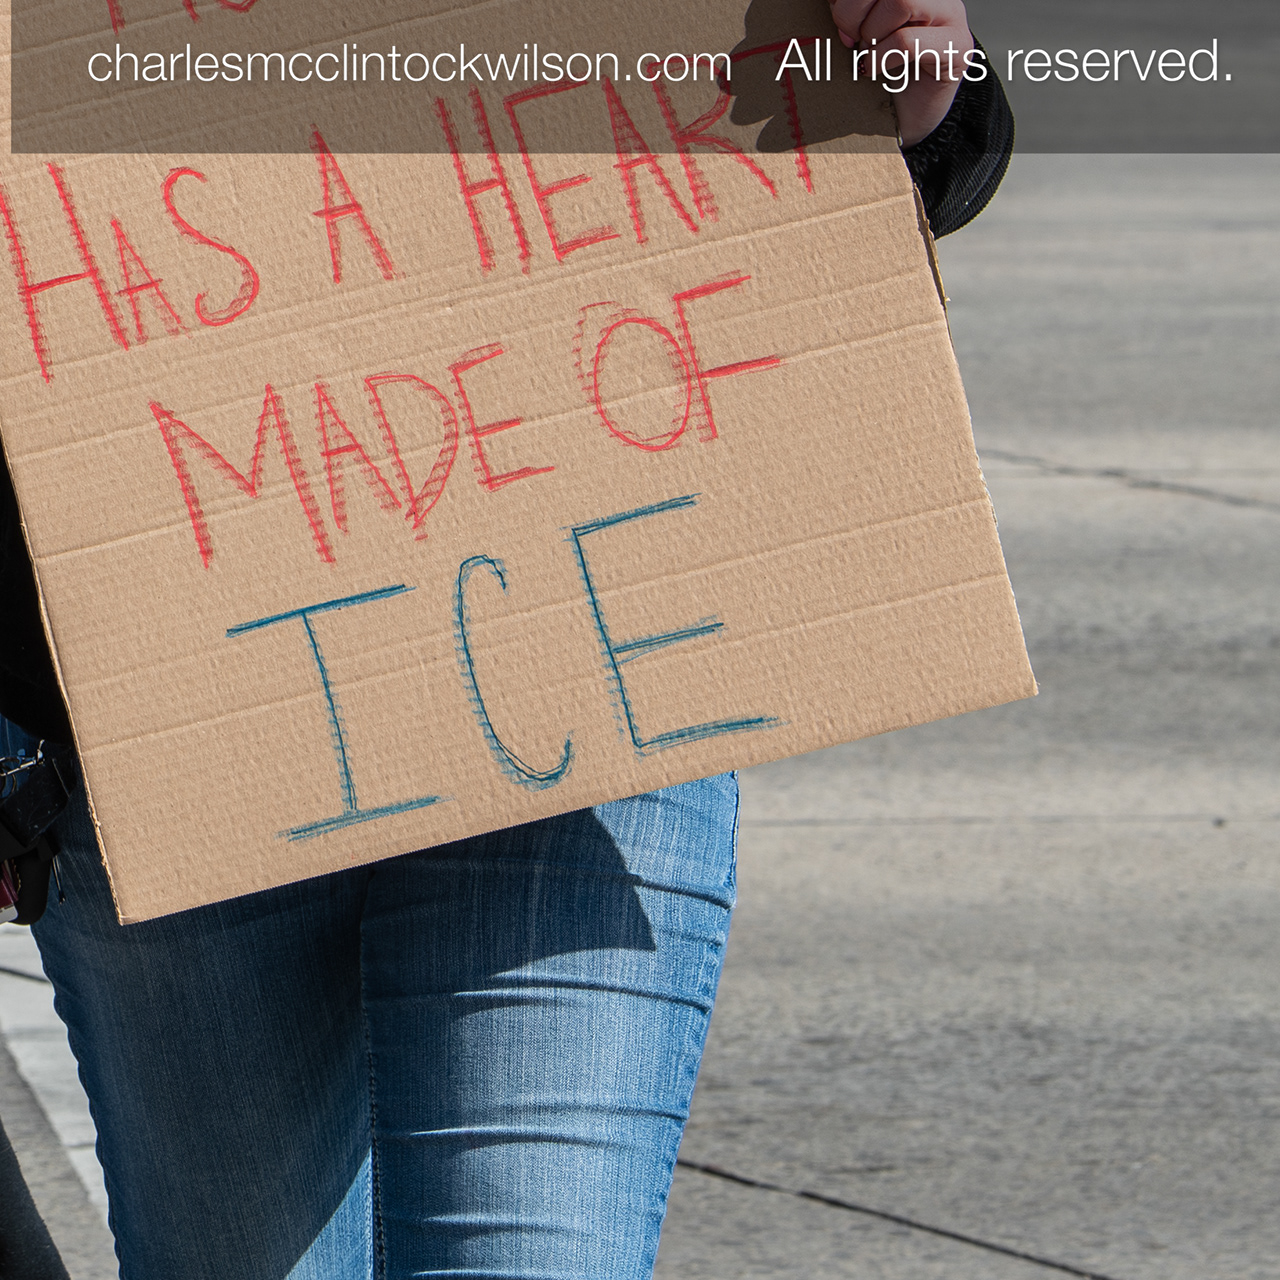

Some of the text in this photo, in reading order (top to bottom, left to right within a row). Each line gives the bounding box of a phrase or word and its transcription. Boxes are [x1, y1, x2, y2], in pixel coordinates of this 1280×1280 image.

[312, 123, 397, 284] A
[435, 34, 828, 275] HEART
[150, 274, 784, 569] MADE OF
[226, 492, 785, 841] ICE
